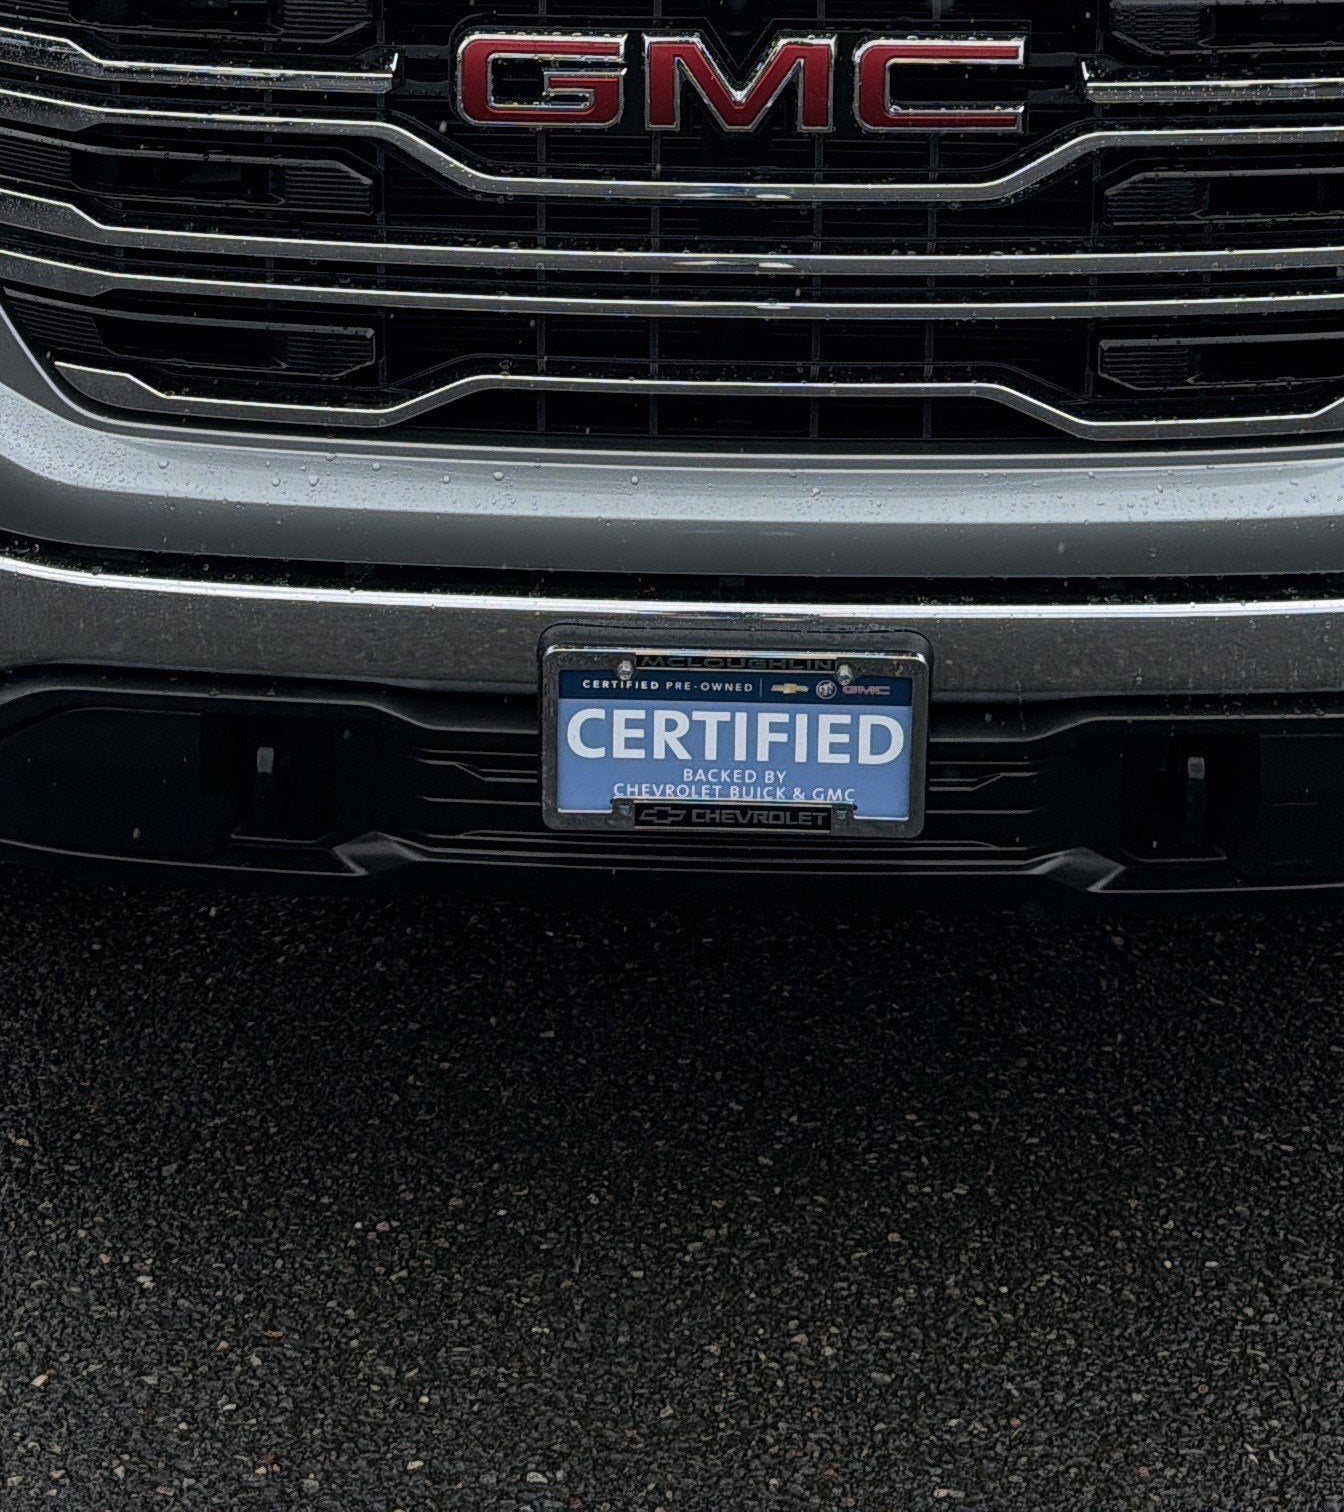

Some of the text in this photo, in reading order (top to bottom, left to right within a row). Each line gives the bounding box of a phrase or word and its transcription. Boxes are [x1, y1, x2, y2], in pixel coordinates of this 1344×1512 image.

[457, 33, 1026, 133] GMC
[640, 654, 833, 671] MCLOUGHLIN
[582, 678, 891, 696] CERTIFIED PRE-OWNED GMC
[567, 708, 905, 765] CERTIFIED
[682, 768, 787, 785] BACKED BY
[613, 782, 856, 802] CHEVROLET BUICK & GMC
[691, 808, 828, 826] CHEVROLET
